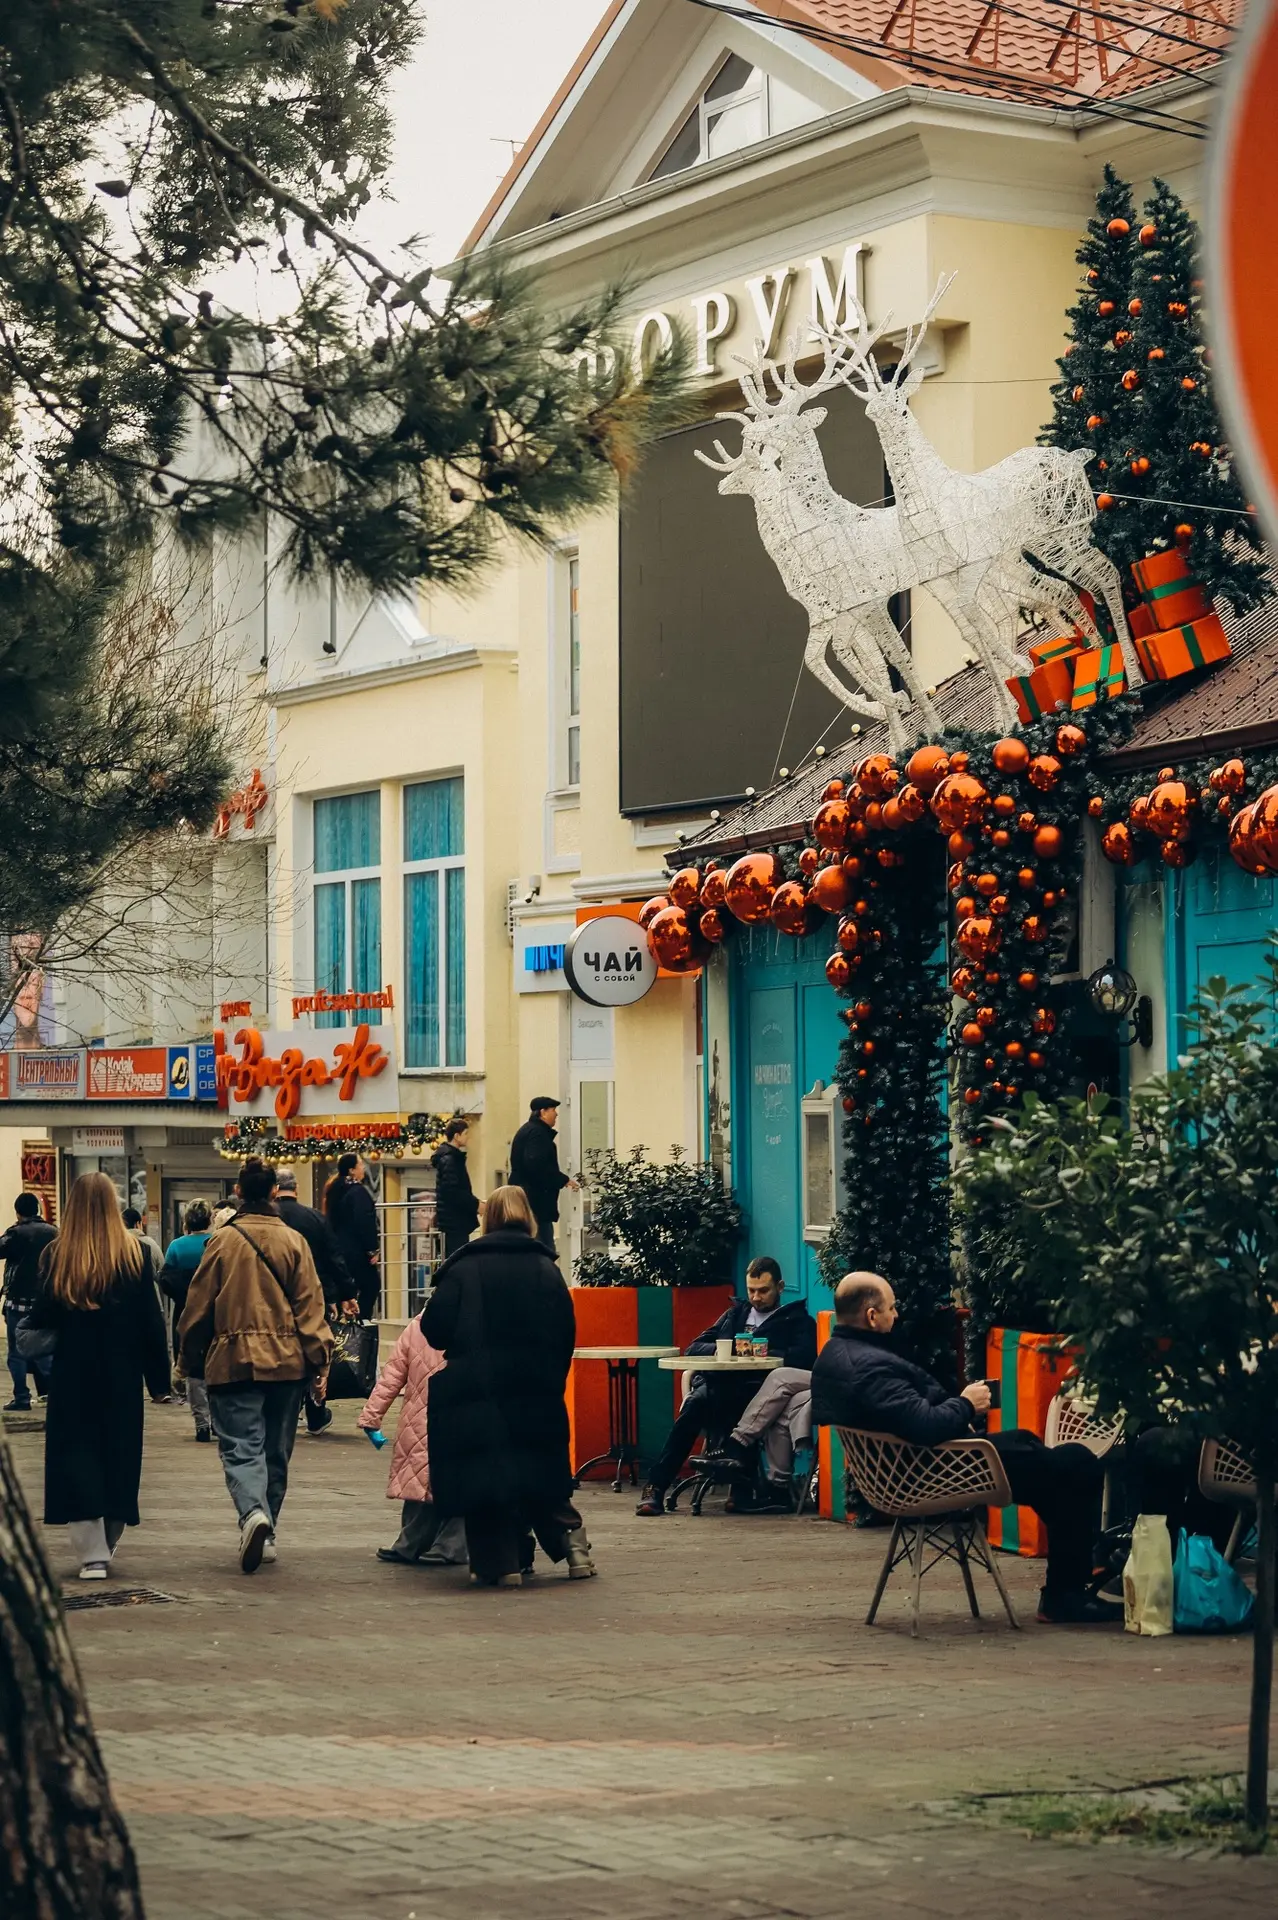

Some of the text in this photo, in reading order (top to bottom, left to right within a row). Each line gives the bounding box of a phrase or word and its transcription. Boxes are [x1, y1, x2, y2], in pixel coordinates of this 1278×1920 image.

[584, 946, 643, 972] ЧАЙ
[604, 973, 636, 982] СОБОЙ
[291, 984, 395, 1020] professional
[107, 1055, 134, 1074] Kodak
[233, 1023, 389, 1120] Визаж
[114, 1073, 164, 1091] EXPRESS
[286, 1122, 401, 1141] ПАРФЮМЕРИЯ
